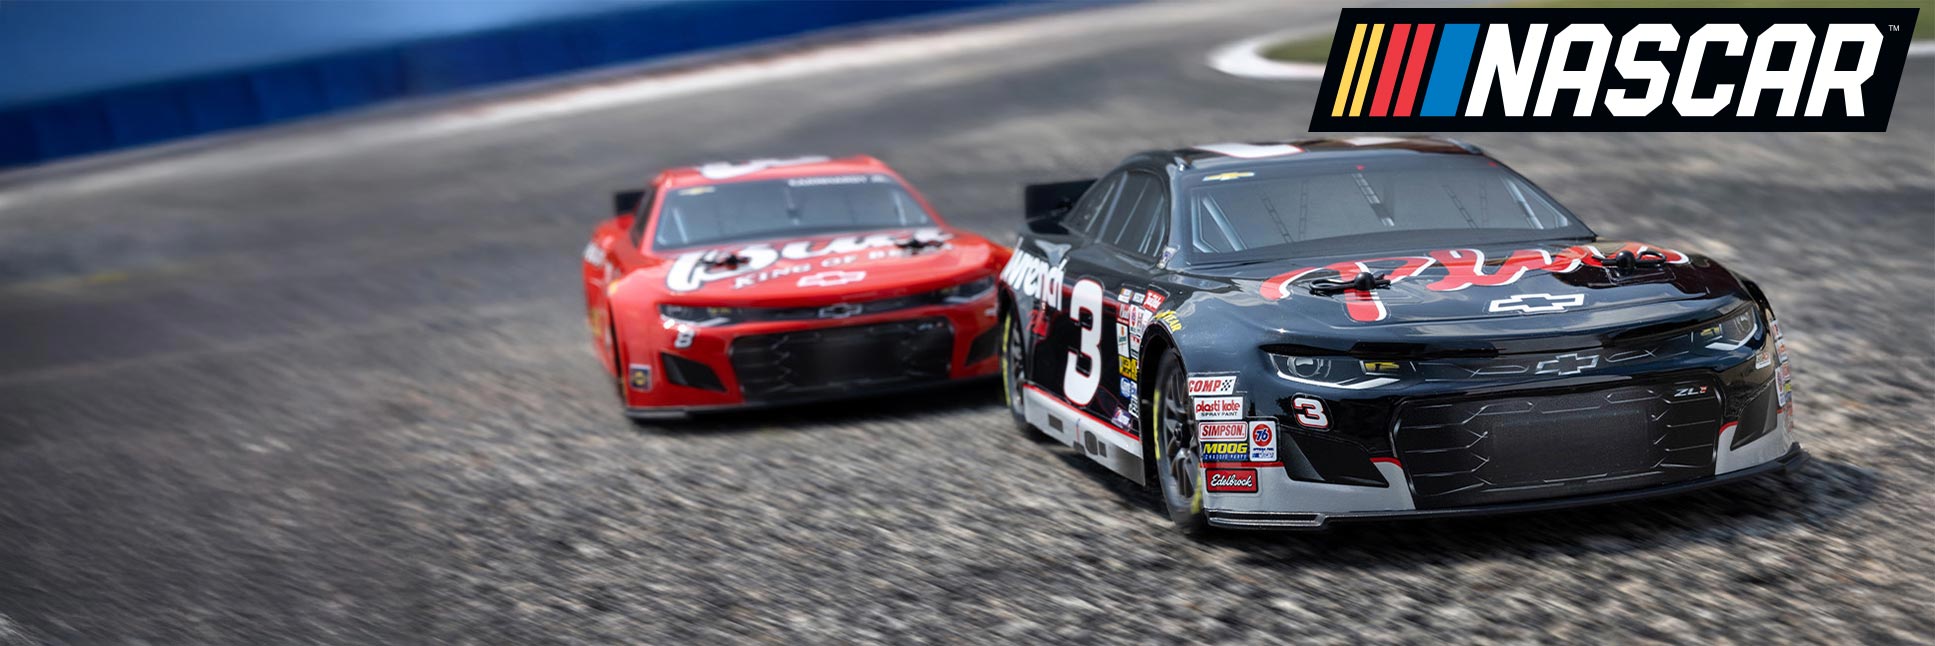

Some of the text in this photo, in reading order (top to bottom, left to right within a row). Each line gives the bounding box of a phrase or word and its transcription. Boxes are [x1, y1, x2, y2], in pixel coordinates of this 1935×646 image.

[1062, 277, 1104, 406] 3
[1188, 379, 1222, 393] COMP
[1293, 396, 1329, 430] 3
[1256, 428, 1269, 441] 76
[1203, 442, 1248, 454] MOOG
[1210, 473, 1253, 487] Edelbrock
